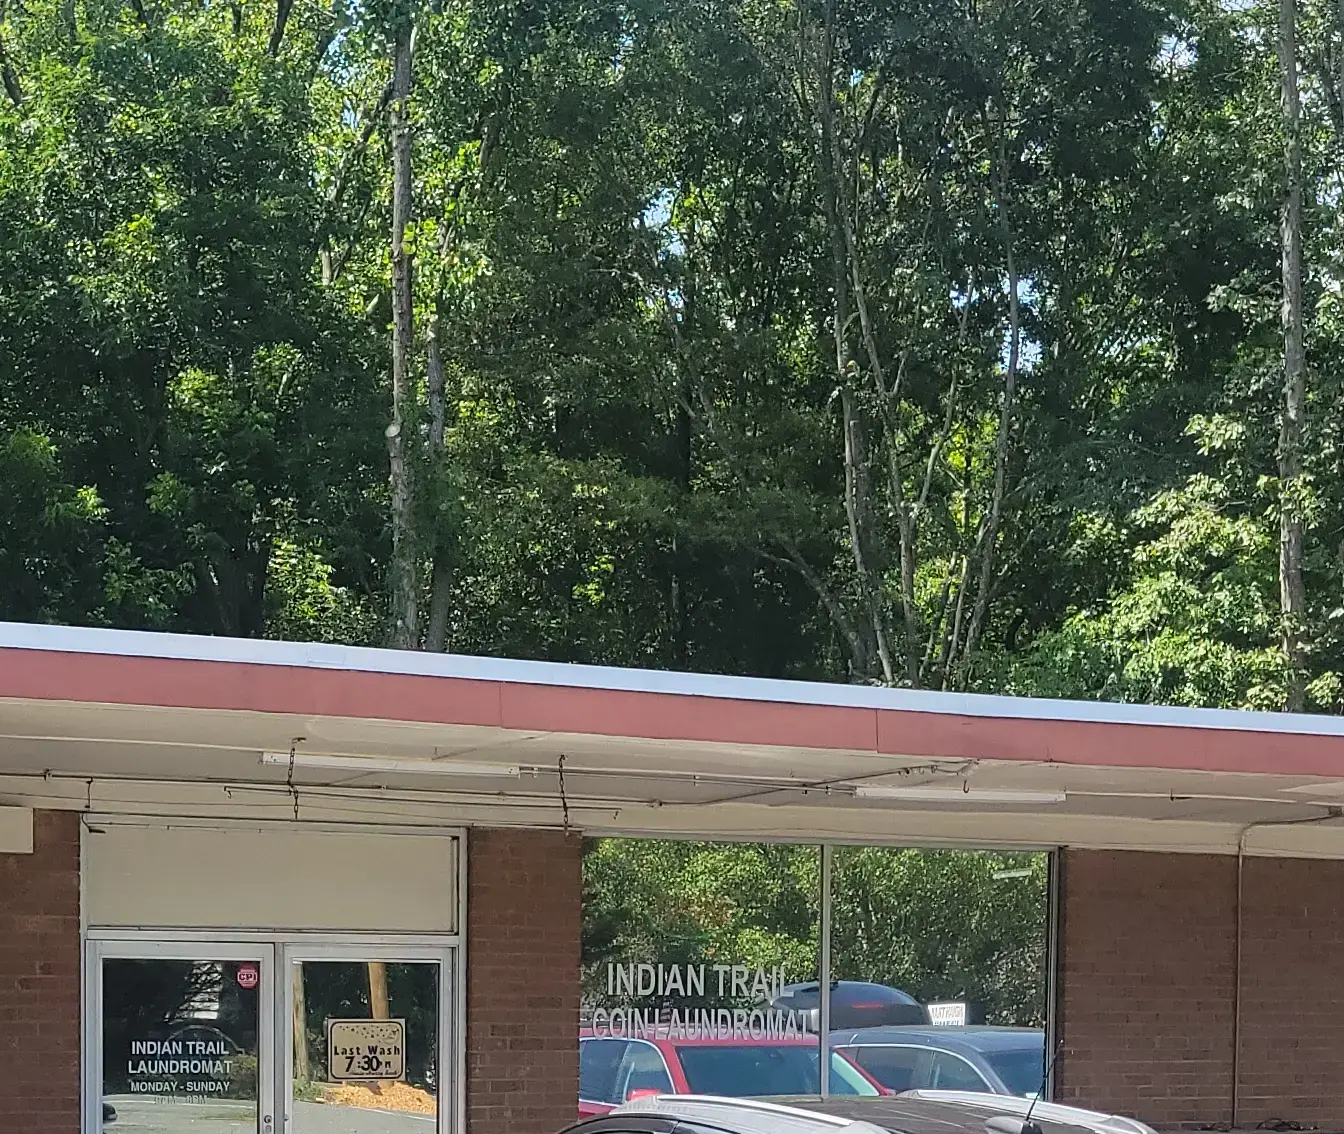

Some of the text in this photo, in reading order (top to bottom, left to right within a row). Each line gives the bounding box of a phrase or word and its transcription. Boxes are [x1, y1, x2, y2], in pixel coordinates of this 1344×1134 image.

[607, 963, 795, 998] INDIAN TRAIL
[592, 1007, 810, 1041] COIN LAUNDROMAT
[131, 1041, 230, 1055] INDIAN TRAIL
[333, 1045, 401, 1056] Last Wash
[128, 1060, 233, 1074] LAUNDROMAT
[130, 1081, 178, 1092] MONDAY
[186, 1081, 231, 1092] SUNDAY
